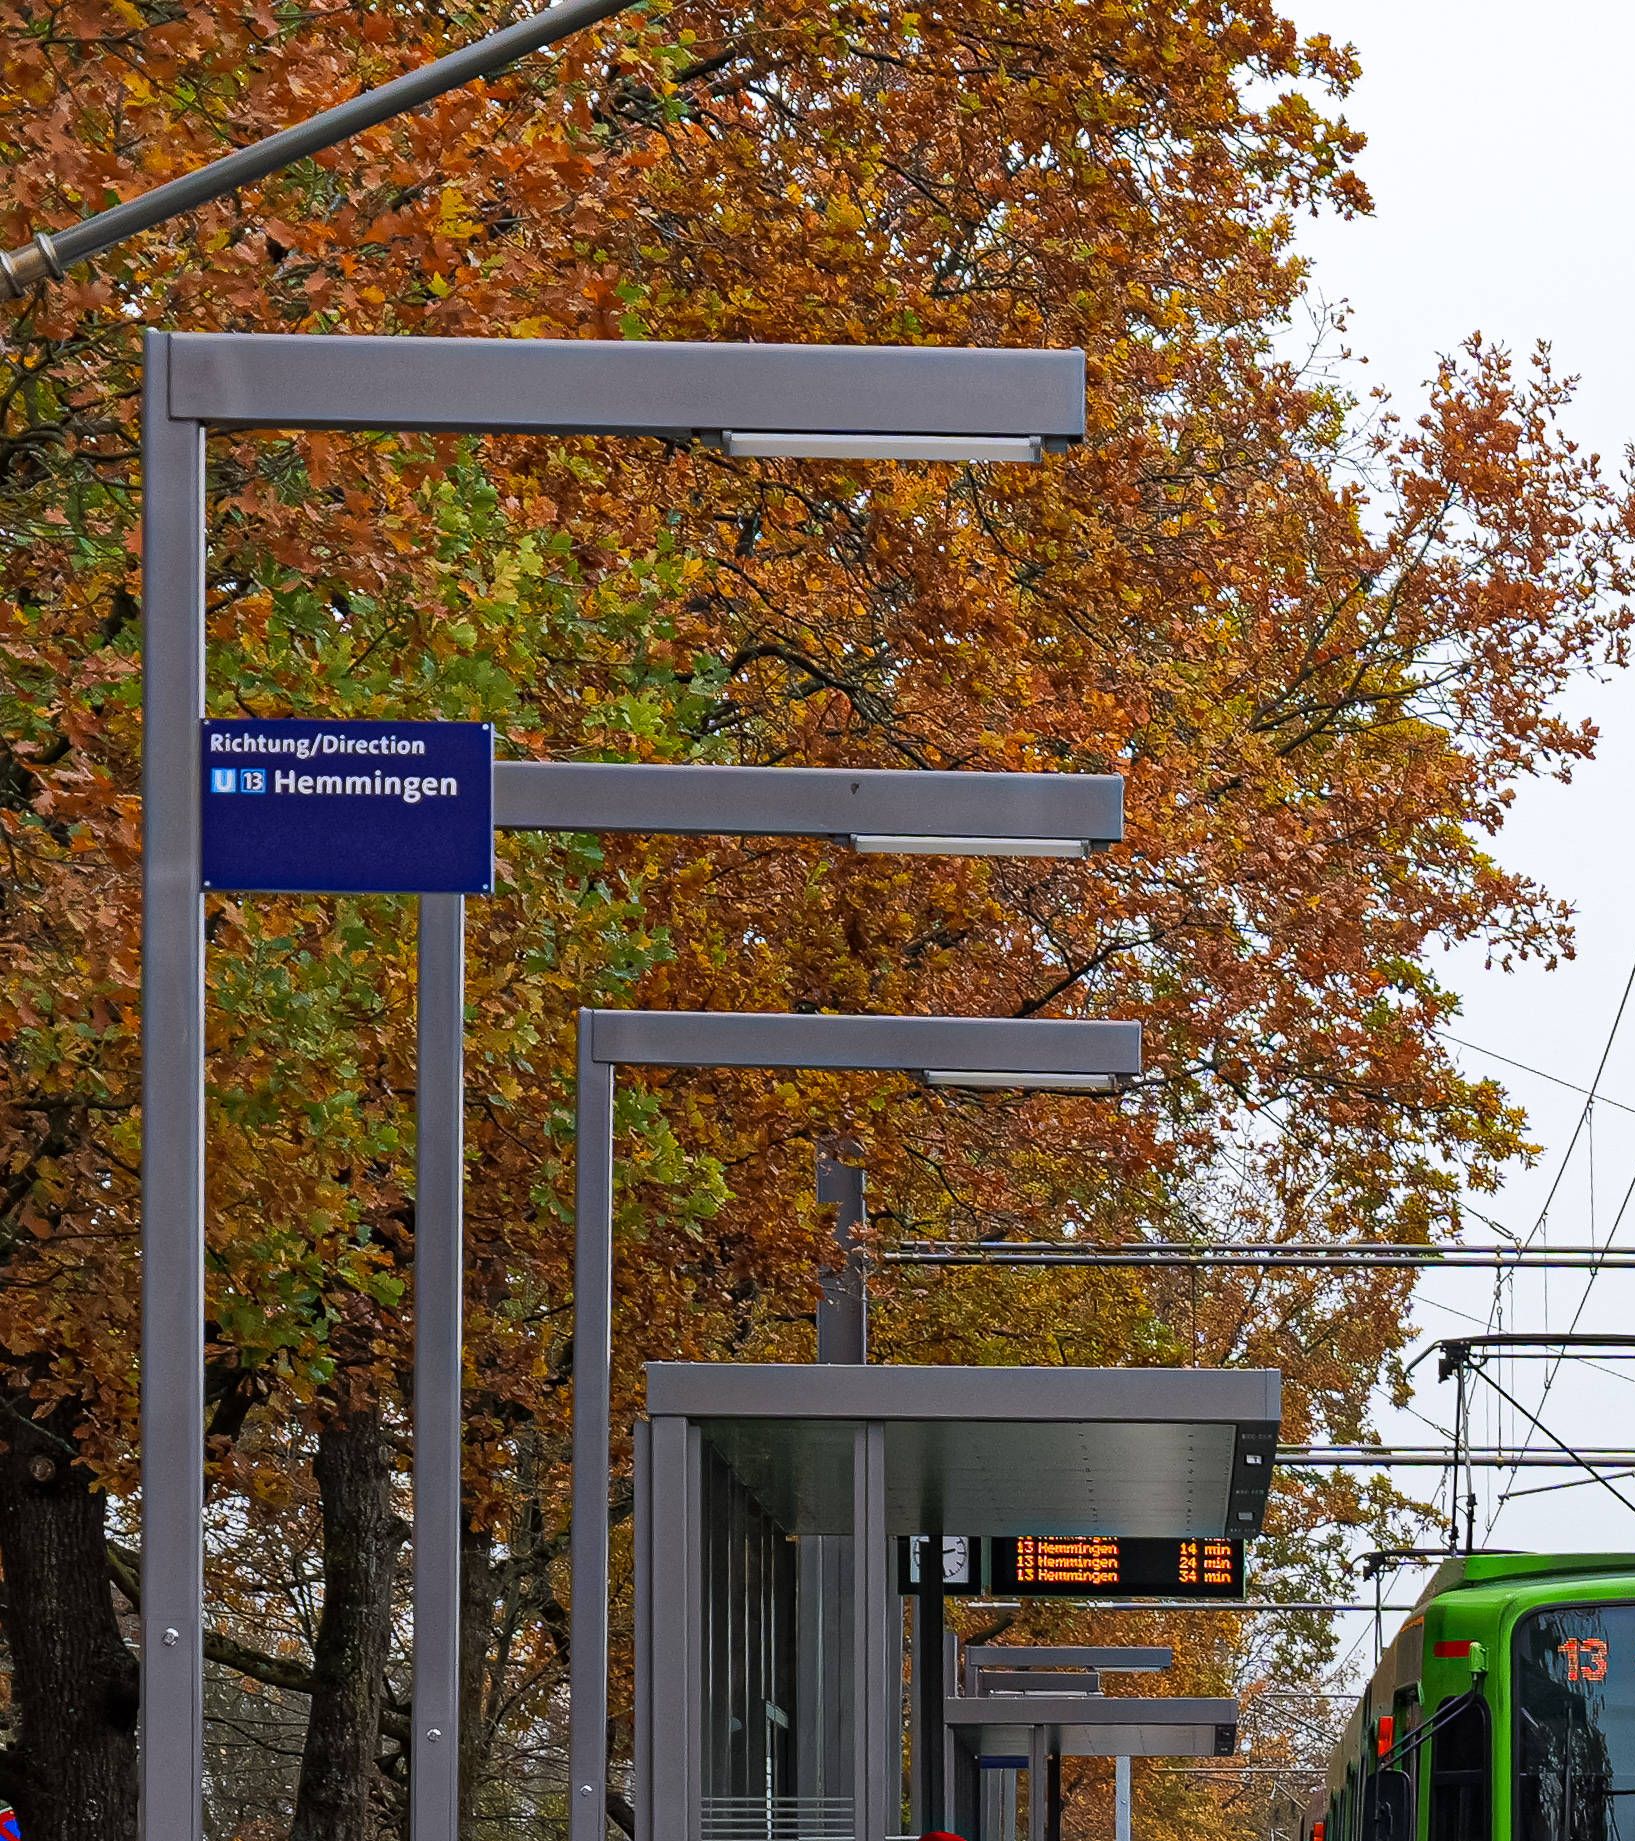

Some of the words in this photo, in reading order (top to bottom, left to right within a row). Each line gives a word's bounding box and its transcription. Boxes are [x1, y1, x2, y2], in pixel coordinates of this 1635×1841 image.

[210, 733, 425, 759] Richtung/Direction
[214, 769, 234, 793] U
[243, 771, 264, 791] 13
[274, 769, 458, 804] Hemmingen
[1017, 1541, 1034, 1554] 13
[1038, 1541, 1119, 1558] Hemmingen
[1180, 1542, 1197, 1555] 14
[1204, 1543, 1232, 1556] min
[1017, 1555, 1034, 1568] 13
[1038, 1555, 1119, 1570] Hemmingen
[1179, 1556, 1198, 1569] 24
[1204, 1556, 1232, 1570] min
[1017, 1569, 1034, 1582] 13
[1038, 1569, 1119, 1584] Hemmingen
[1179, 1570, 1197, 1583] 34
[1204, 1570, 1232, 1583] min
[1558, 1637, 1608, 1682] 13
